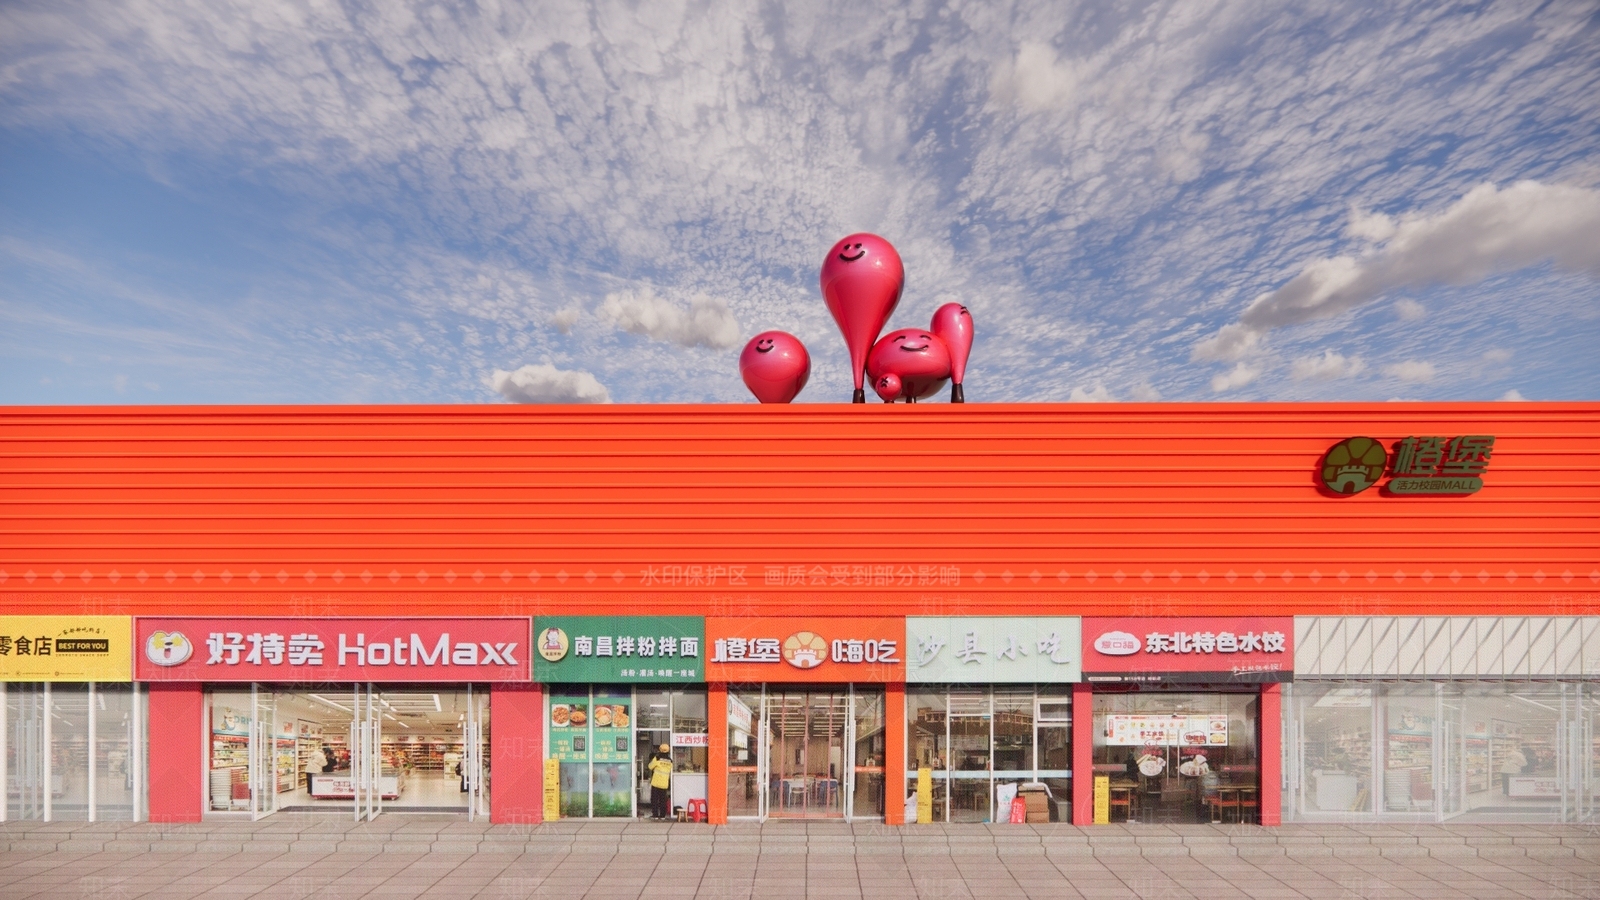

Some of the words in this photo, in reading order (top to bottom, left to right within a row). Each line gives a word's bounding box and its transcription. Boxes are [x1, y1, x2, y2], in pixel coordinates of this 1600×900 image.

[1393, 435, 1496, 475] 橙堡
[1396, 480, 1476, 490] 活力校园MALL
[58, 642, 76, 650] BEST
[77, 642, 91, 650] FOR
[91, 642, 107, 650] YOU
[574, 635, 699, 657] 南昌拌粉拌面
[710, 637, 781, 663] 橙堡
[831, 638, 900, 663] 嗨吃
[916, 631, 1071, 668] 沙县小吃
[1145, 631, 1286, 653] 东北特色水饺
